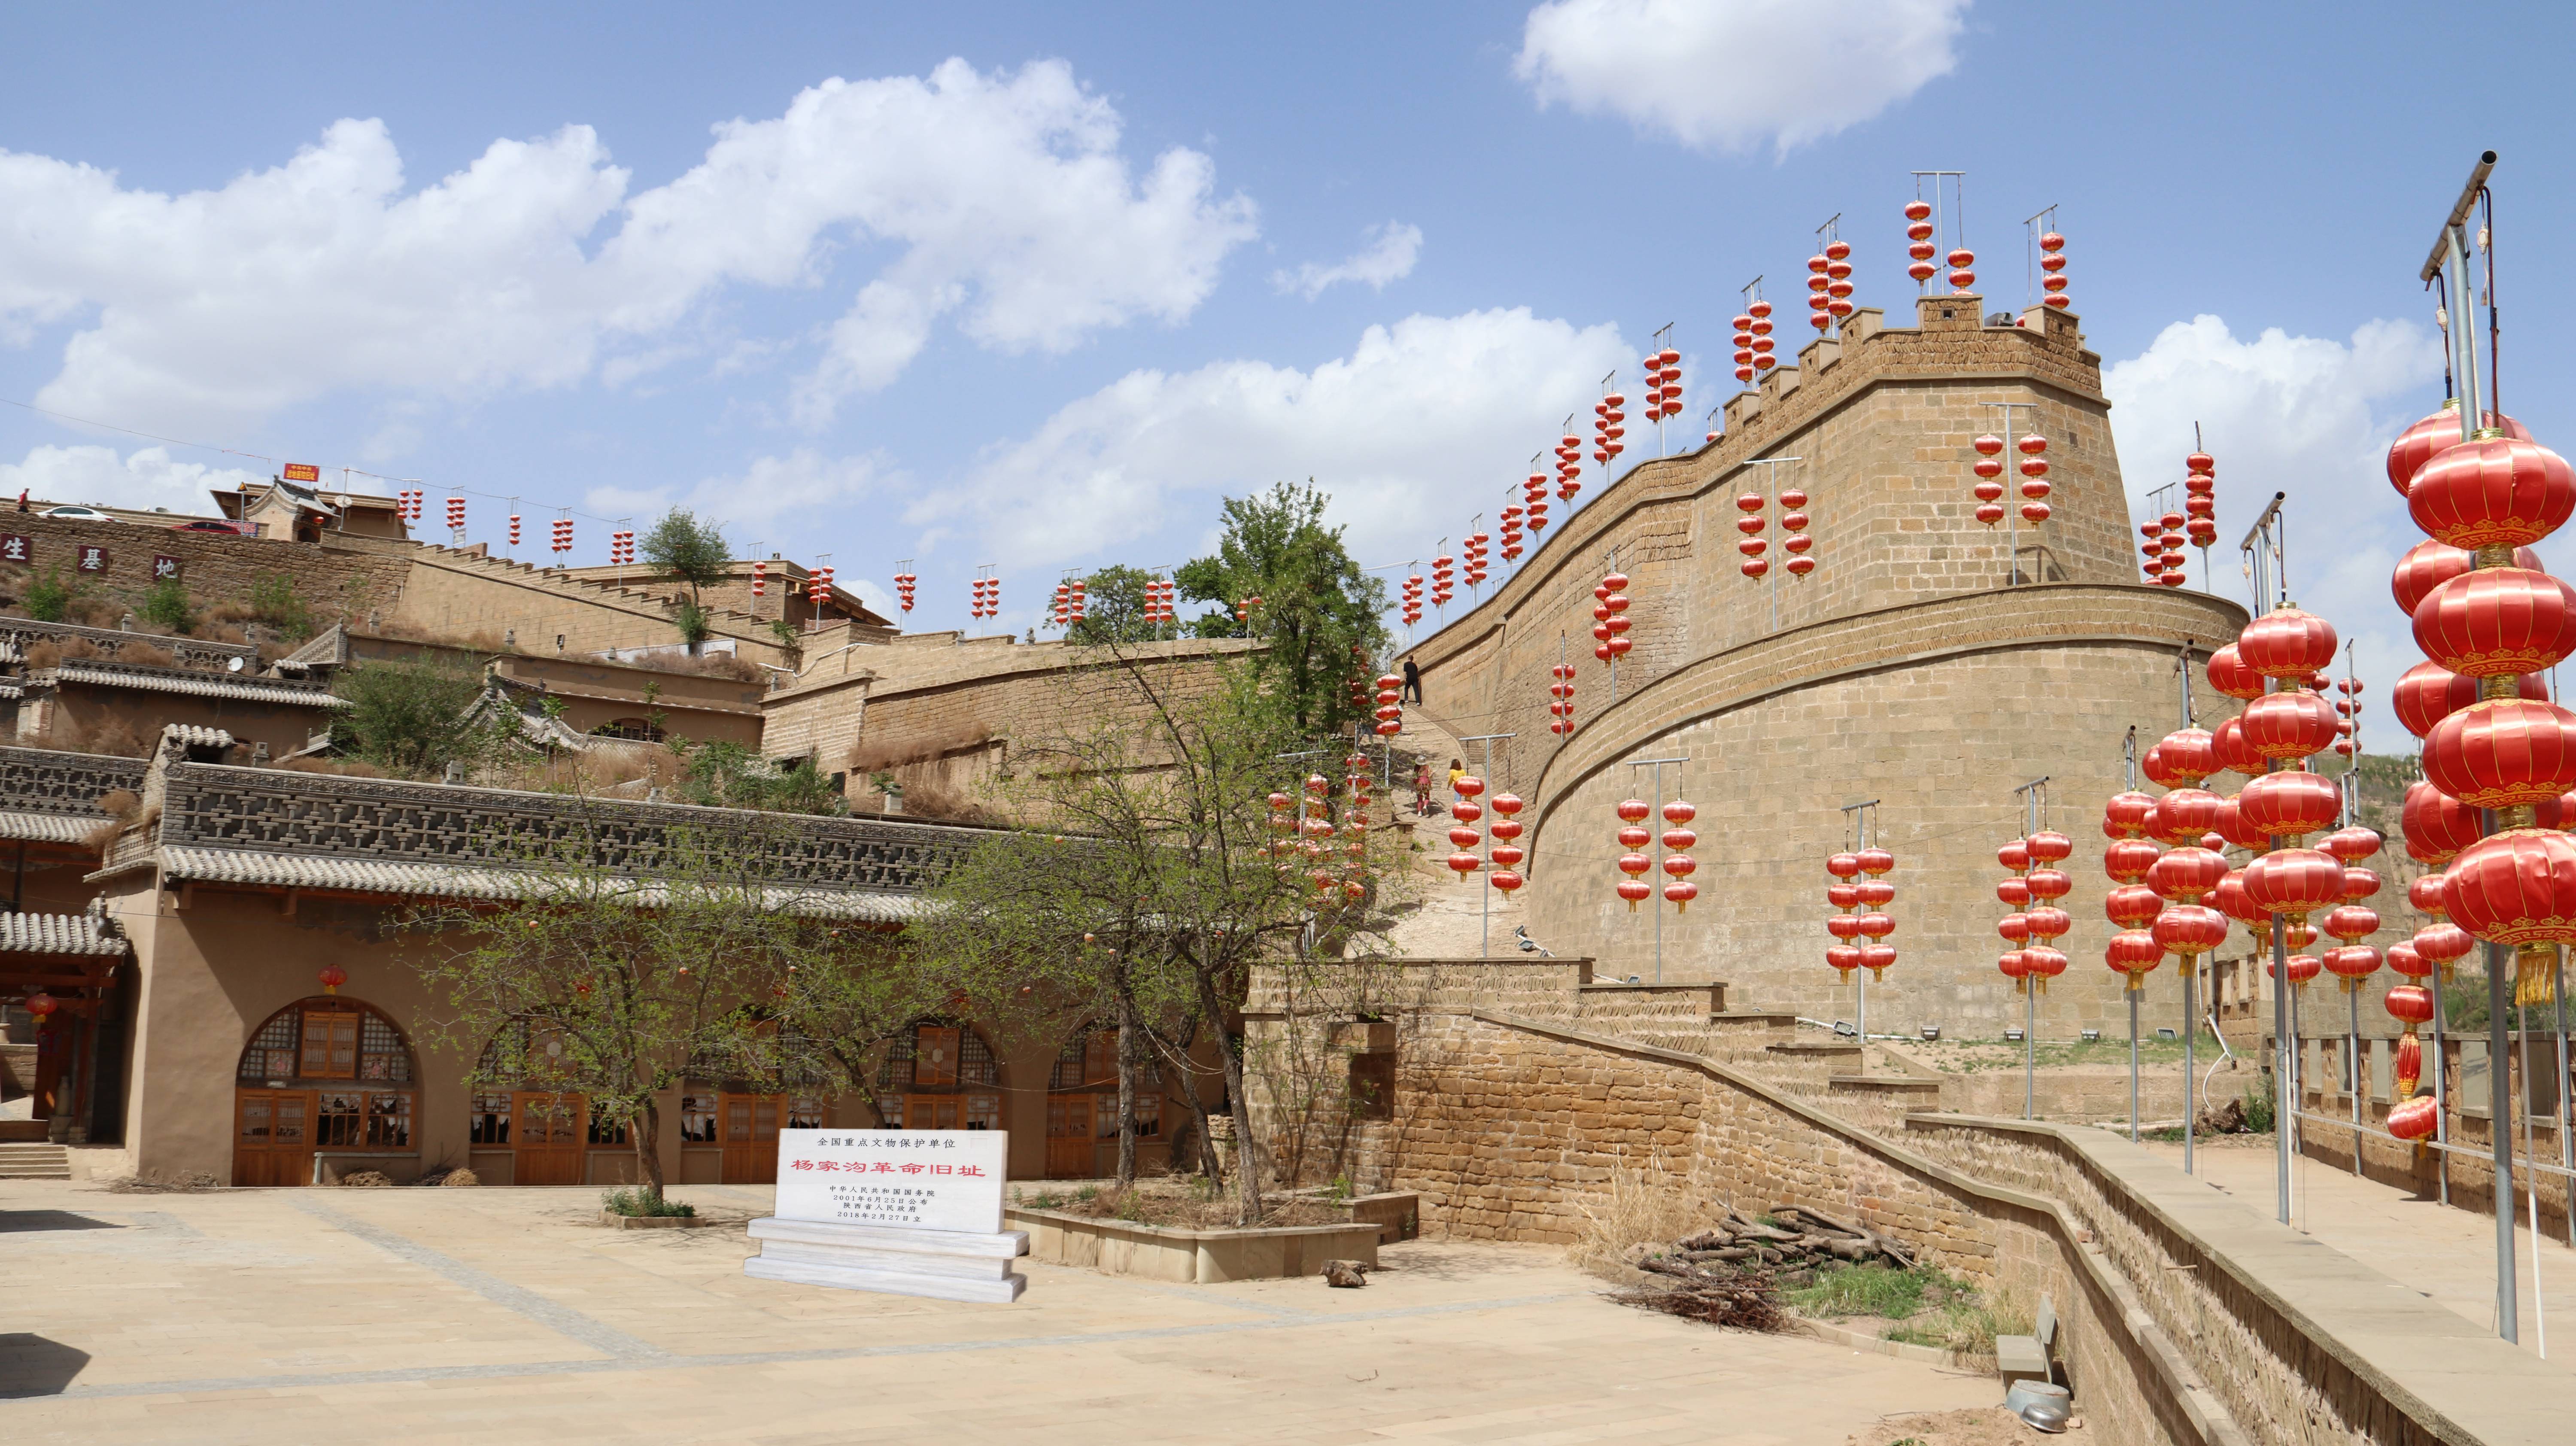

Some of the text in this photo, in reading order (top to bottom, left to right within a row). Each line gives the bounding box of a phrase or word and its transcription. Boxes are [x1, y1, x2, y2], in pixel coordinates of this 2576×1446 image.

[3, 537, 177, 579] 生 基 地
[817, 1137, 956, 1149] 全国重点文物保护单位
[790, 1160, 986, 1177] 杨家沟革命旧址
[830, 1185, 935, 1197] 中华人民共和国国务院
[833, 1195, 927, 1205] 2001年6月25日公布
[843, 1202, 917, 1212] 陕西省人民政府
[838, 1212, 921, 1222] 2018年2月27日立
